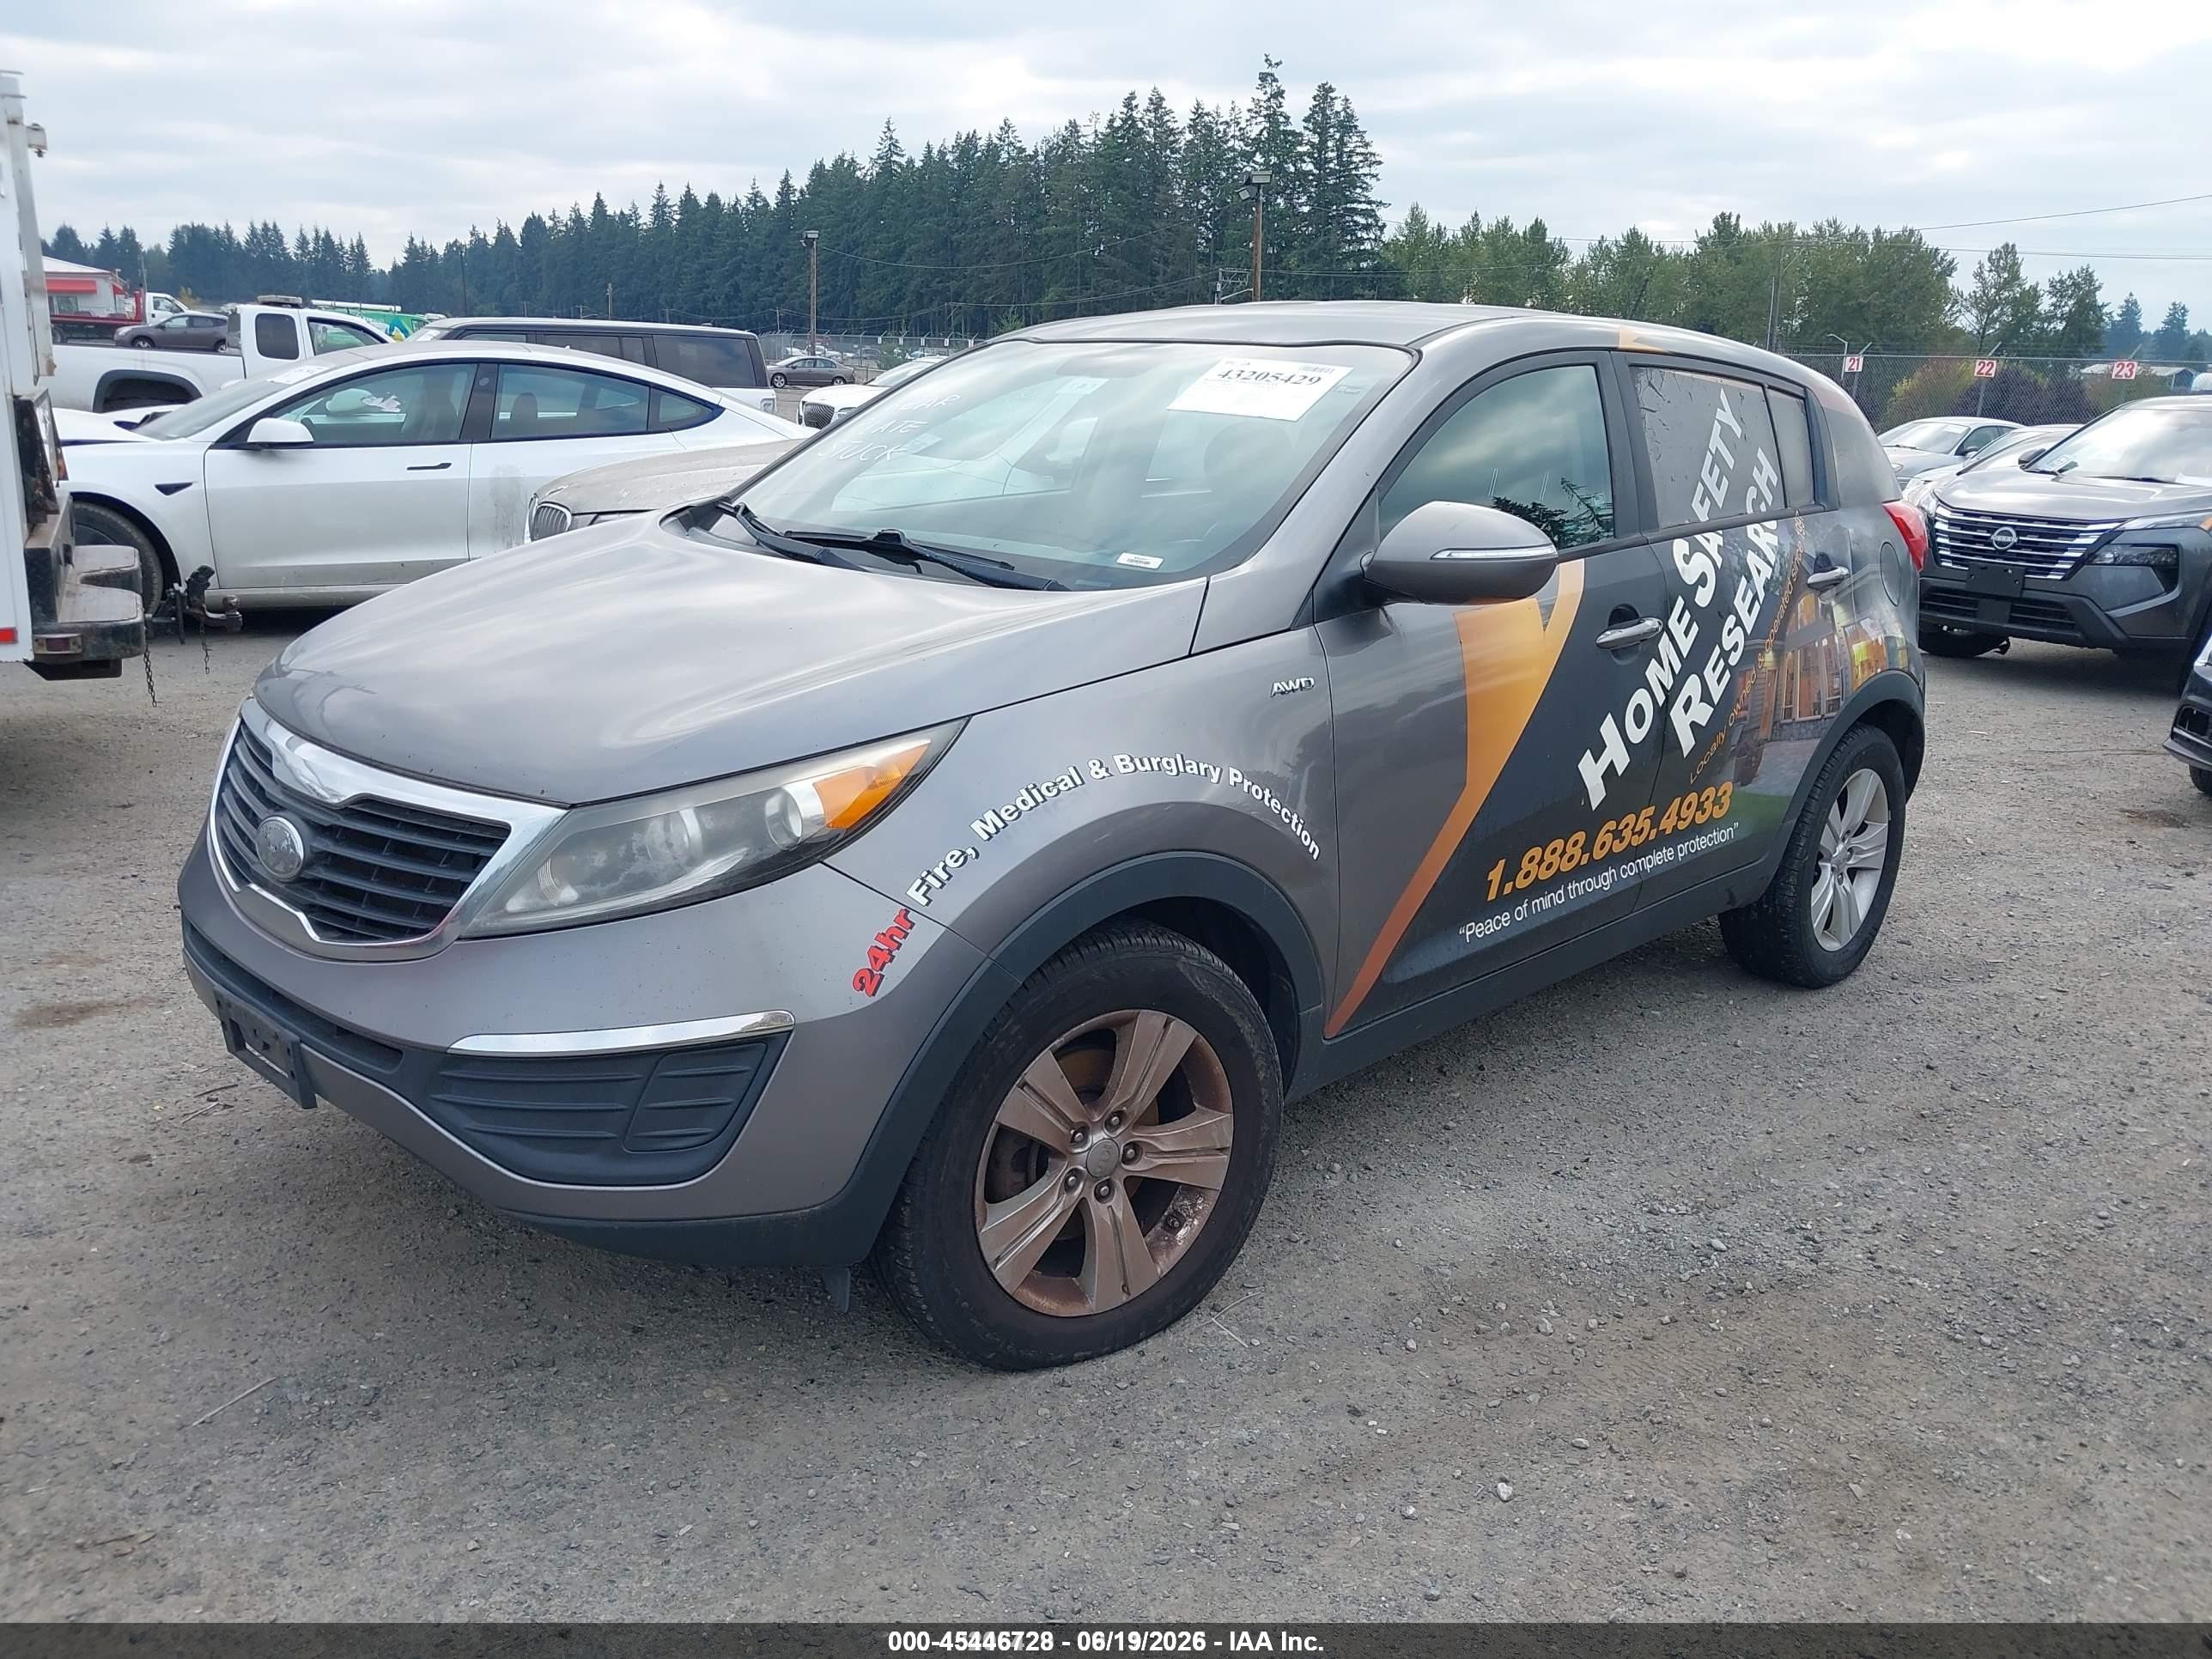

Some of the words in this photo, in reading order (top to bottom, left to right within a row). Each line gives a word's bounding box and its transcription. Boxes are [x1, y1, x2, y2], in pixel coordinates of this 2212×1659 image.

[1218, 368, 1322, 386] 43205429
[1848, 357, 1861, 371] 21
[1978, 361, 1994, 376] 22
[2115, 362, 2136, 379] 23
[817, 440, 908, 462] STUCK
[1577, 595, 1699, 811] HOME
[1672, 388, 1742, 608] SAFETY
[1669, 447, 1778, 759] RESEARCH
[1271, 677, 1315, 697] AWD
[1690, 724, 1727, 785] Locally
[1729, 665, 1756, 727] owned
[1758, 652, 1765, 668] &
[1765, 575, 1794, 653] operated
[1791, 541, 1804, 582] since
[1486, 781, 1734, 902] 1.888.635.4933
[852, 908, 917, 999] 24hr
[906, 843, 981, 907] Fire,
[969, 766, 1085, 842] Medical
[1087, 758, 1112, 781] &
[1112, 752, 1224, 785] Burglary
[1229, 766, 1322, 860] Protection
[1514, 902, 1528, 921] of
[1531, 884, 1565, 915] mind
[1566, 866, 1618, 900] through
[1620, 846, 1675, 879] complete
